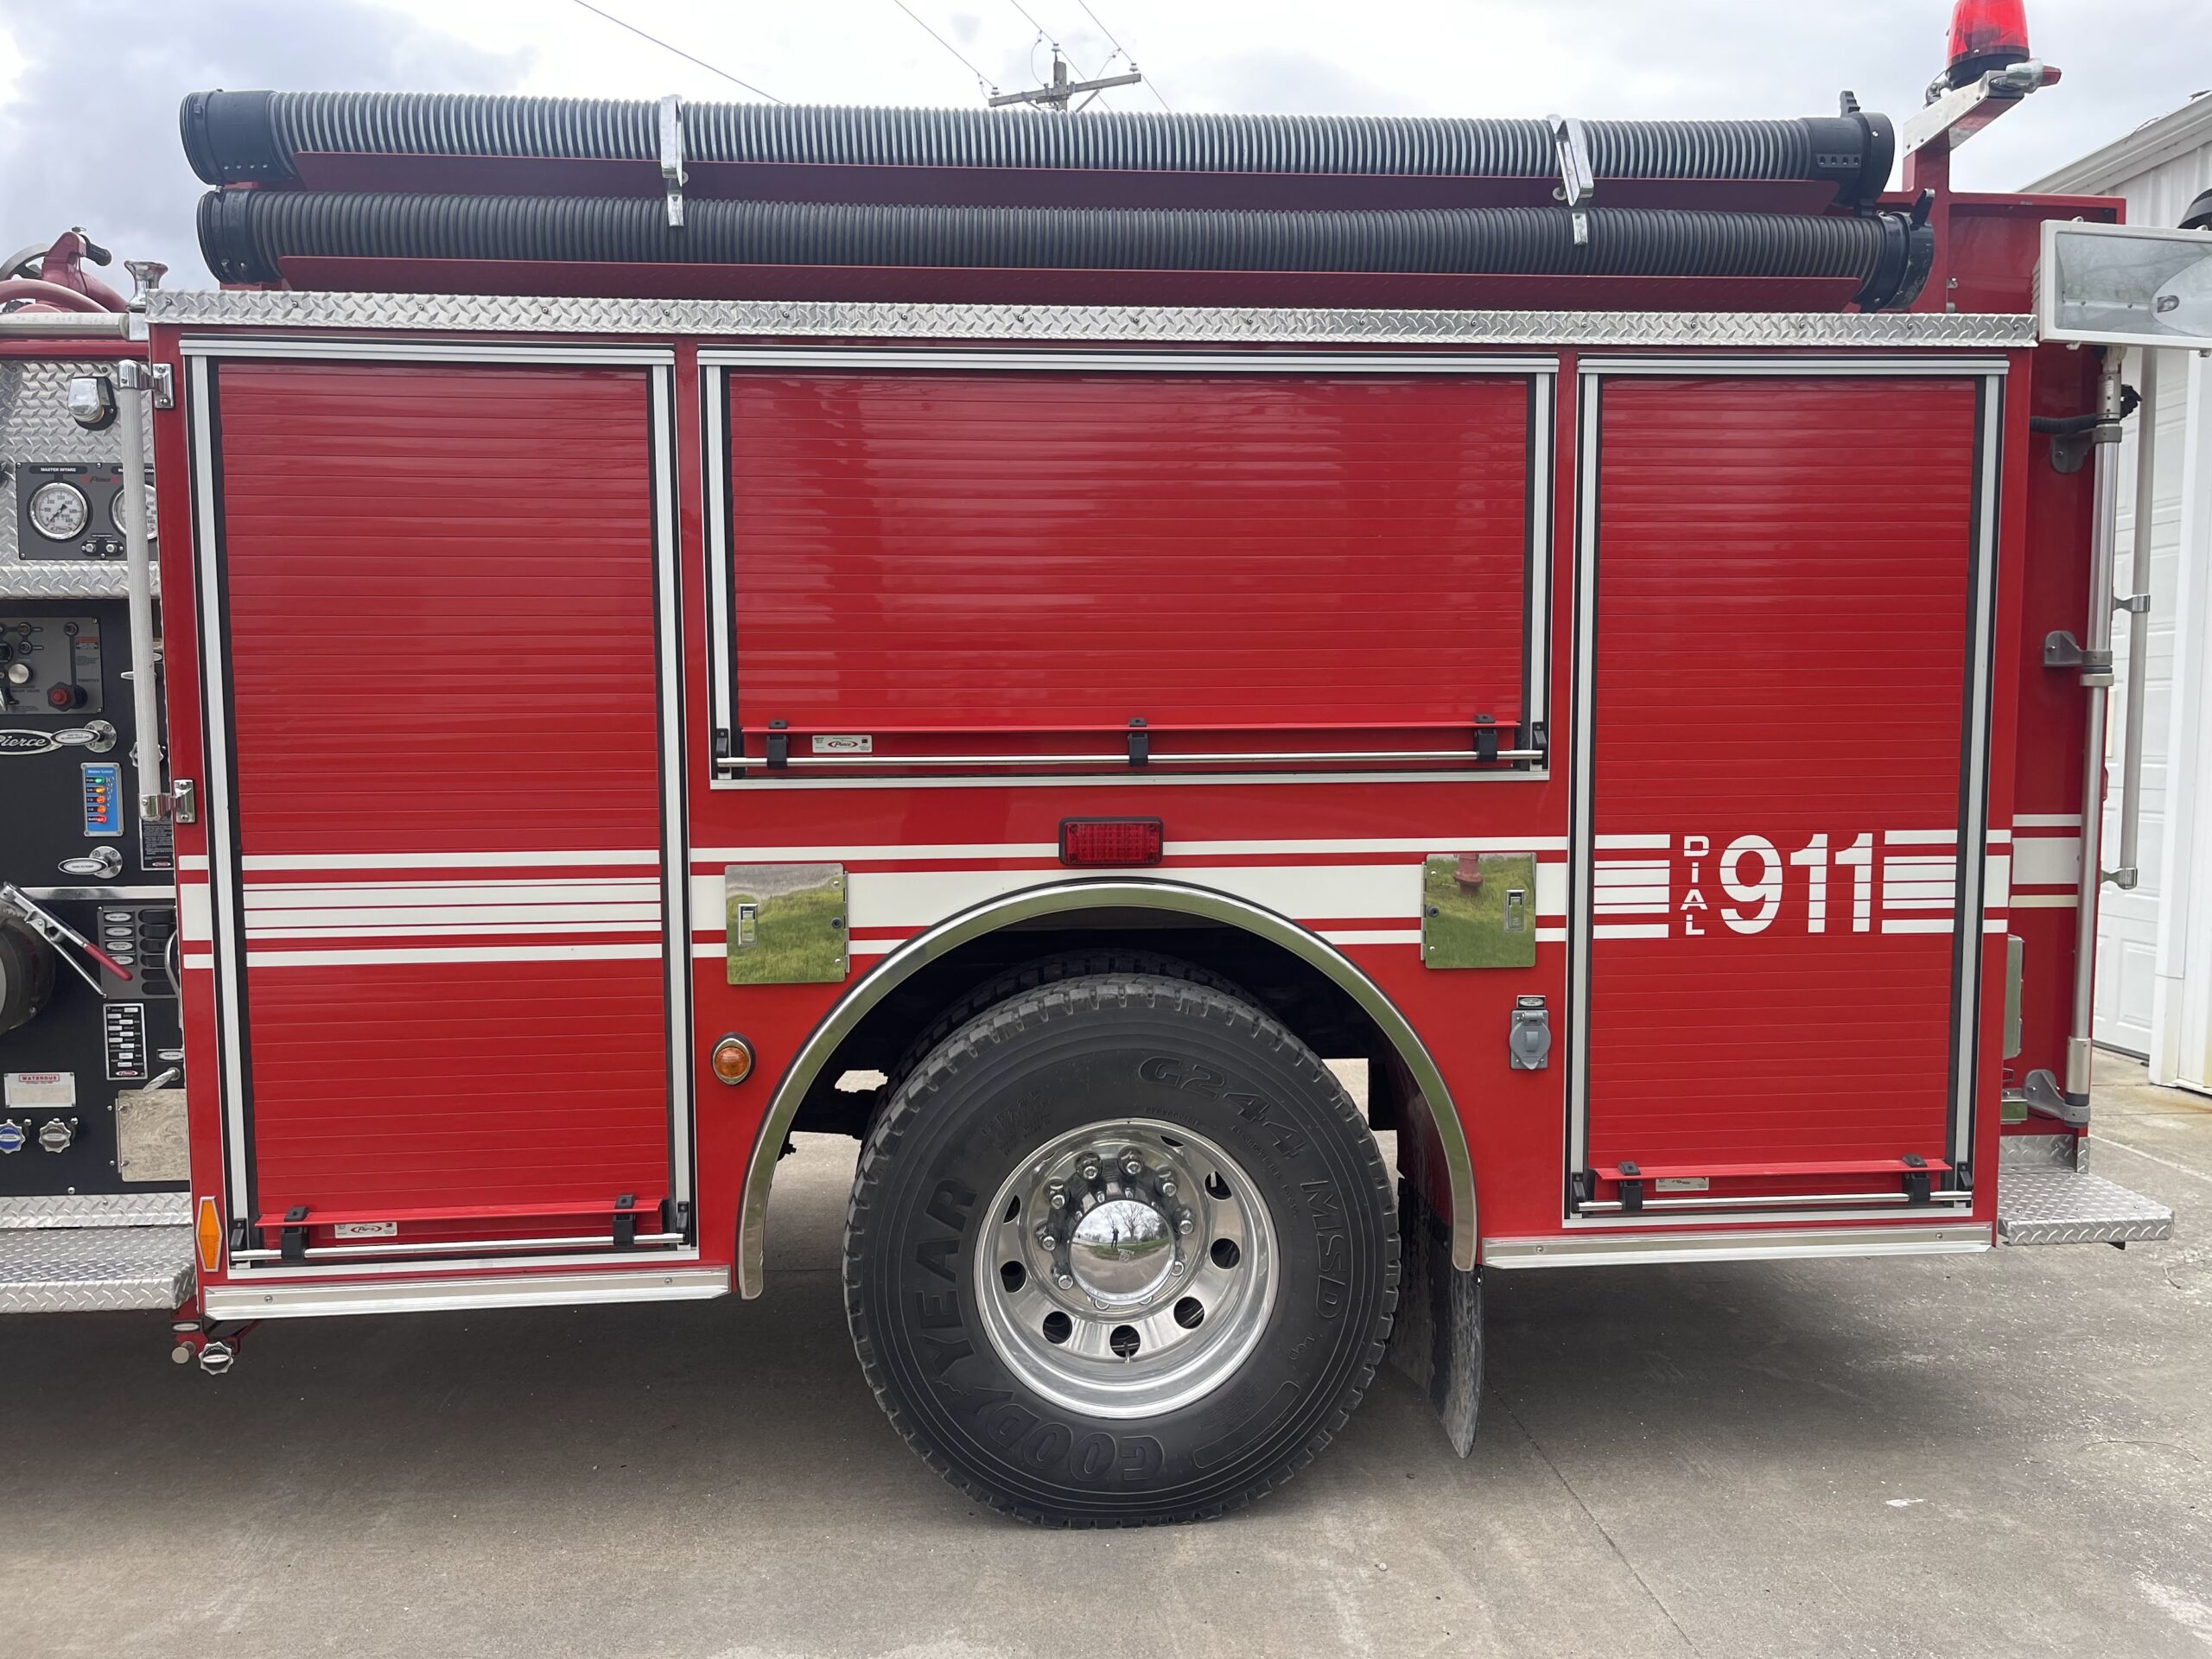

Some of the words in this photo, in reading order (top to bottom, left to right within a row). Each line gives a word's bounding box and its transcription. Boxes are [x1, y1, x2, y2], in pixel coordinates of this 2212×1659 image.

[1680, 836, 1710, 936] DIAL
[1719, 833, 1872, 934] 911
[1138, 1055, 1306, 1159] G244
[1300, 1178, 1343, 1320] MSD
[912, 1176, 1166, 1481] GOODYEAR
